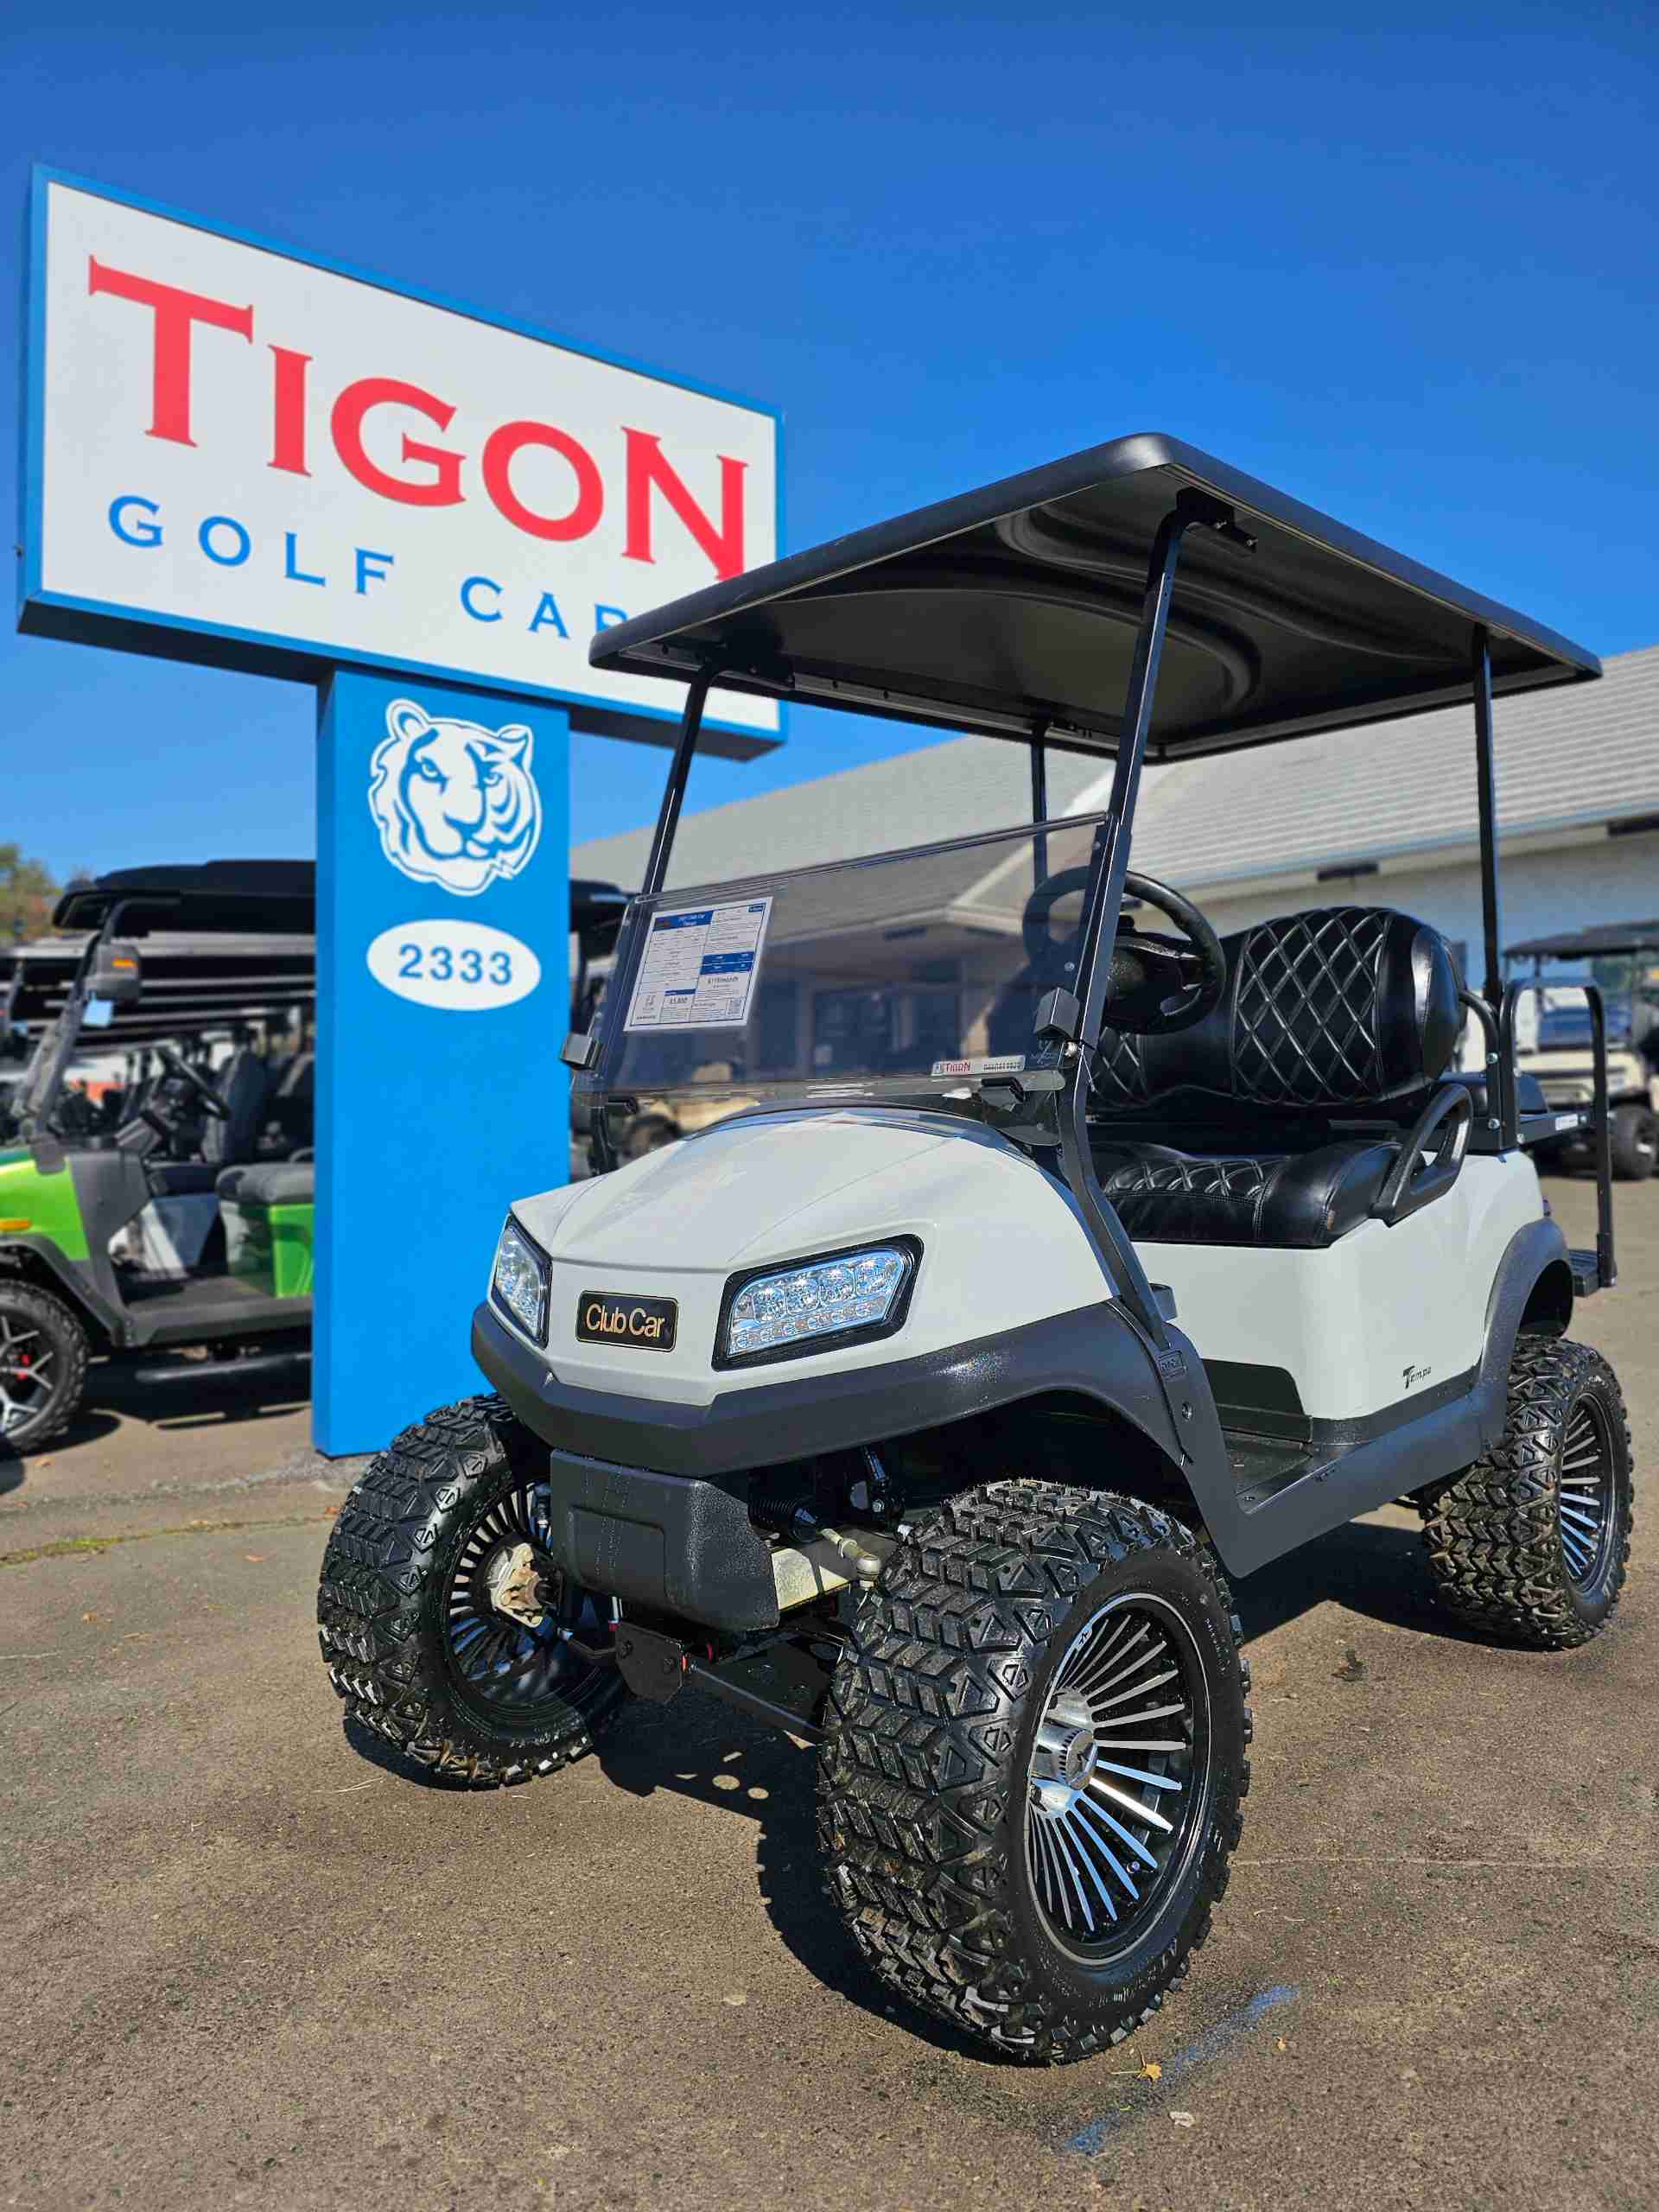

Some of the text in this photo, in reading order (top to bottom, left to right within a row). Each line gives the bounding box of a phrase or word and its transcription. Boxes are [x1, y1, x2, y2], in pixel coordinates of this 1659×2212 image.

[89, 254, 749, 582] TIGON
[108, 495, 394, 595] GOLF
[397, 943, 513, 986] 2333
[586, 1302, 664, 1338] Club Car
